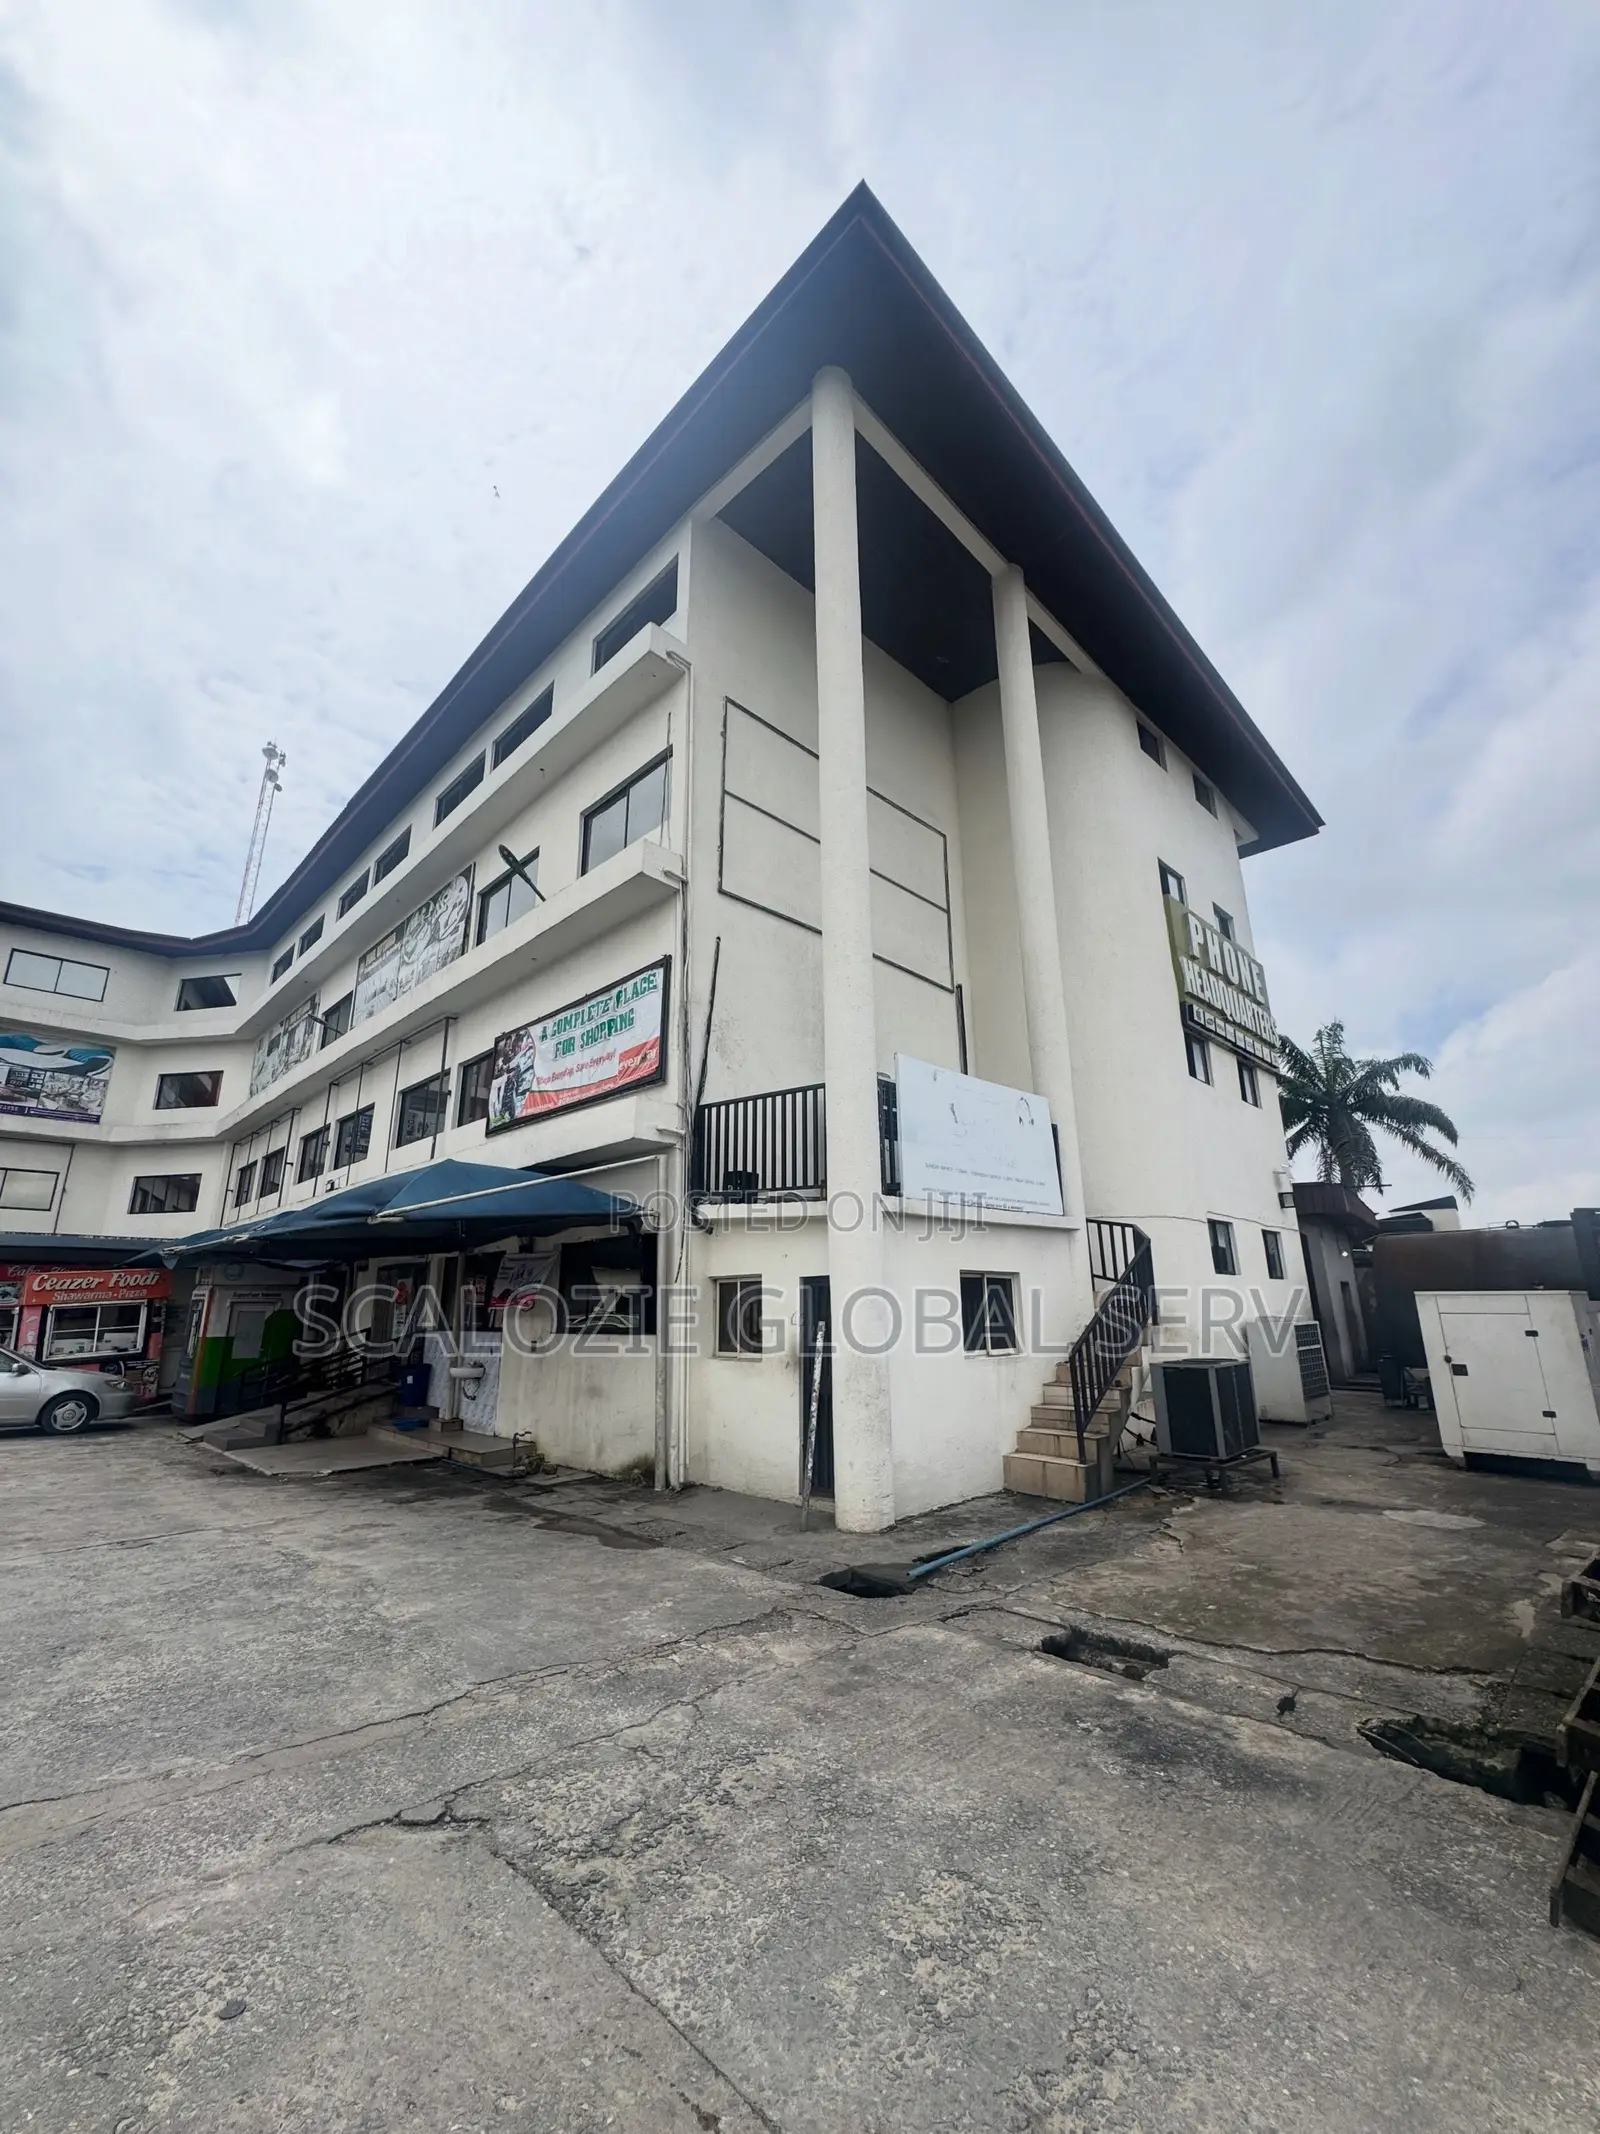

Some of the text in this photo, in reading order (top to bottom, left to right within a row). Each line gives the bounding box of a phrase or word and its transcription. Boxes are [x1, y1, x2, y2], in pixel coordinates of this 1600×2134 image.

[1187, 912, 1265, 1005] PHONE
[540, 1026, 548, 1042] A
[551, 996, 613, 1038] COMPLETE
[1180, 956, 1280, 1048] HEADQUARTERS
[555, 1008, 634, 1059] FOR SHOPPING
[32, 1274, 104, 1291] Ceazer
[53, 1289, 147, 1301] Shawarma Pizza
